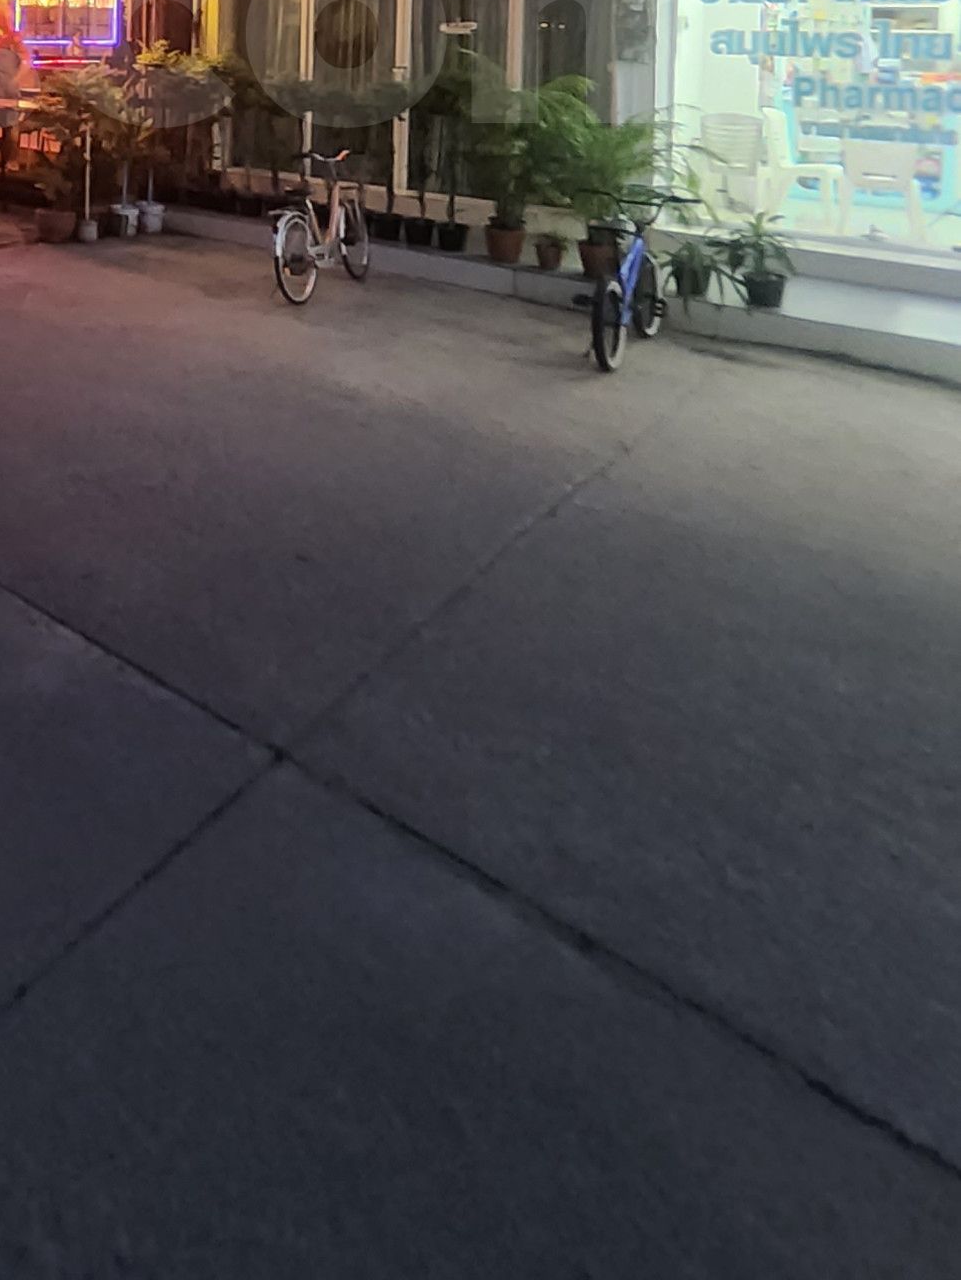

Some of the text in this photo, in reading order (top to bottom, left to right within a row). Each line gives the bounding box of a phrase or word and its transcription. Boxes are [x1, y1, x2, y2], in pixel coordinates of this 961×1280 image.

[709, 11, 953, 65] สมุนไพร ไทย
